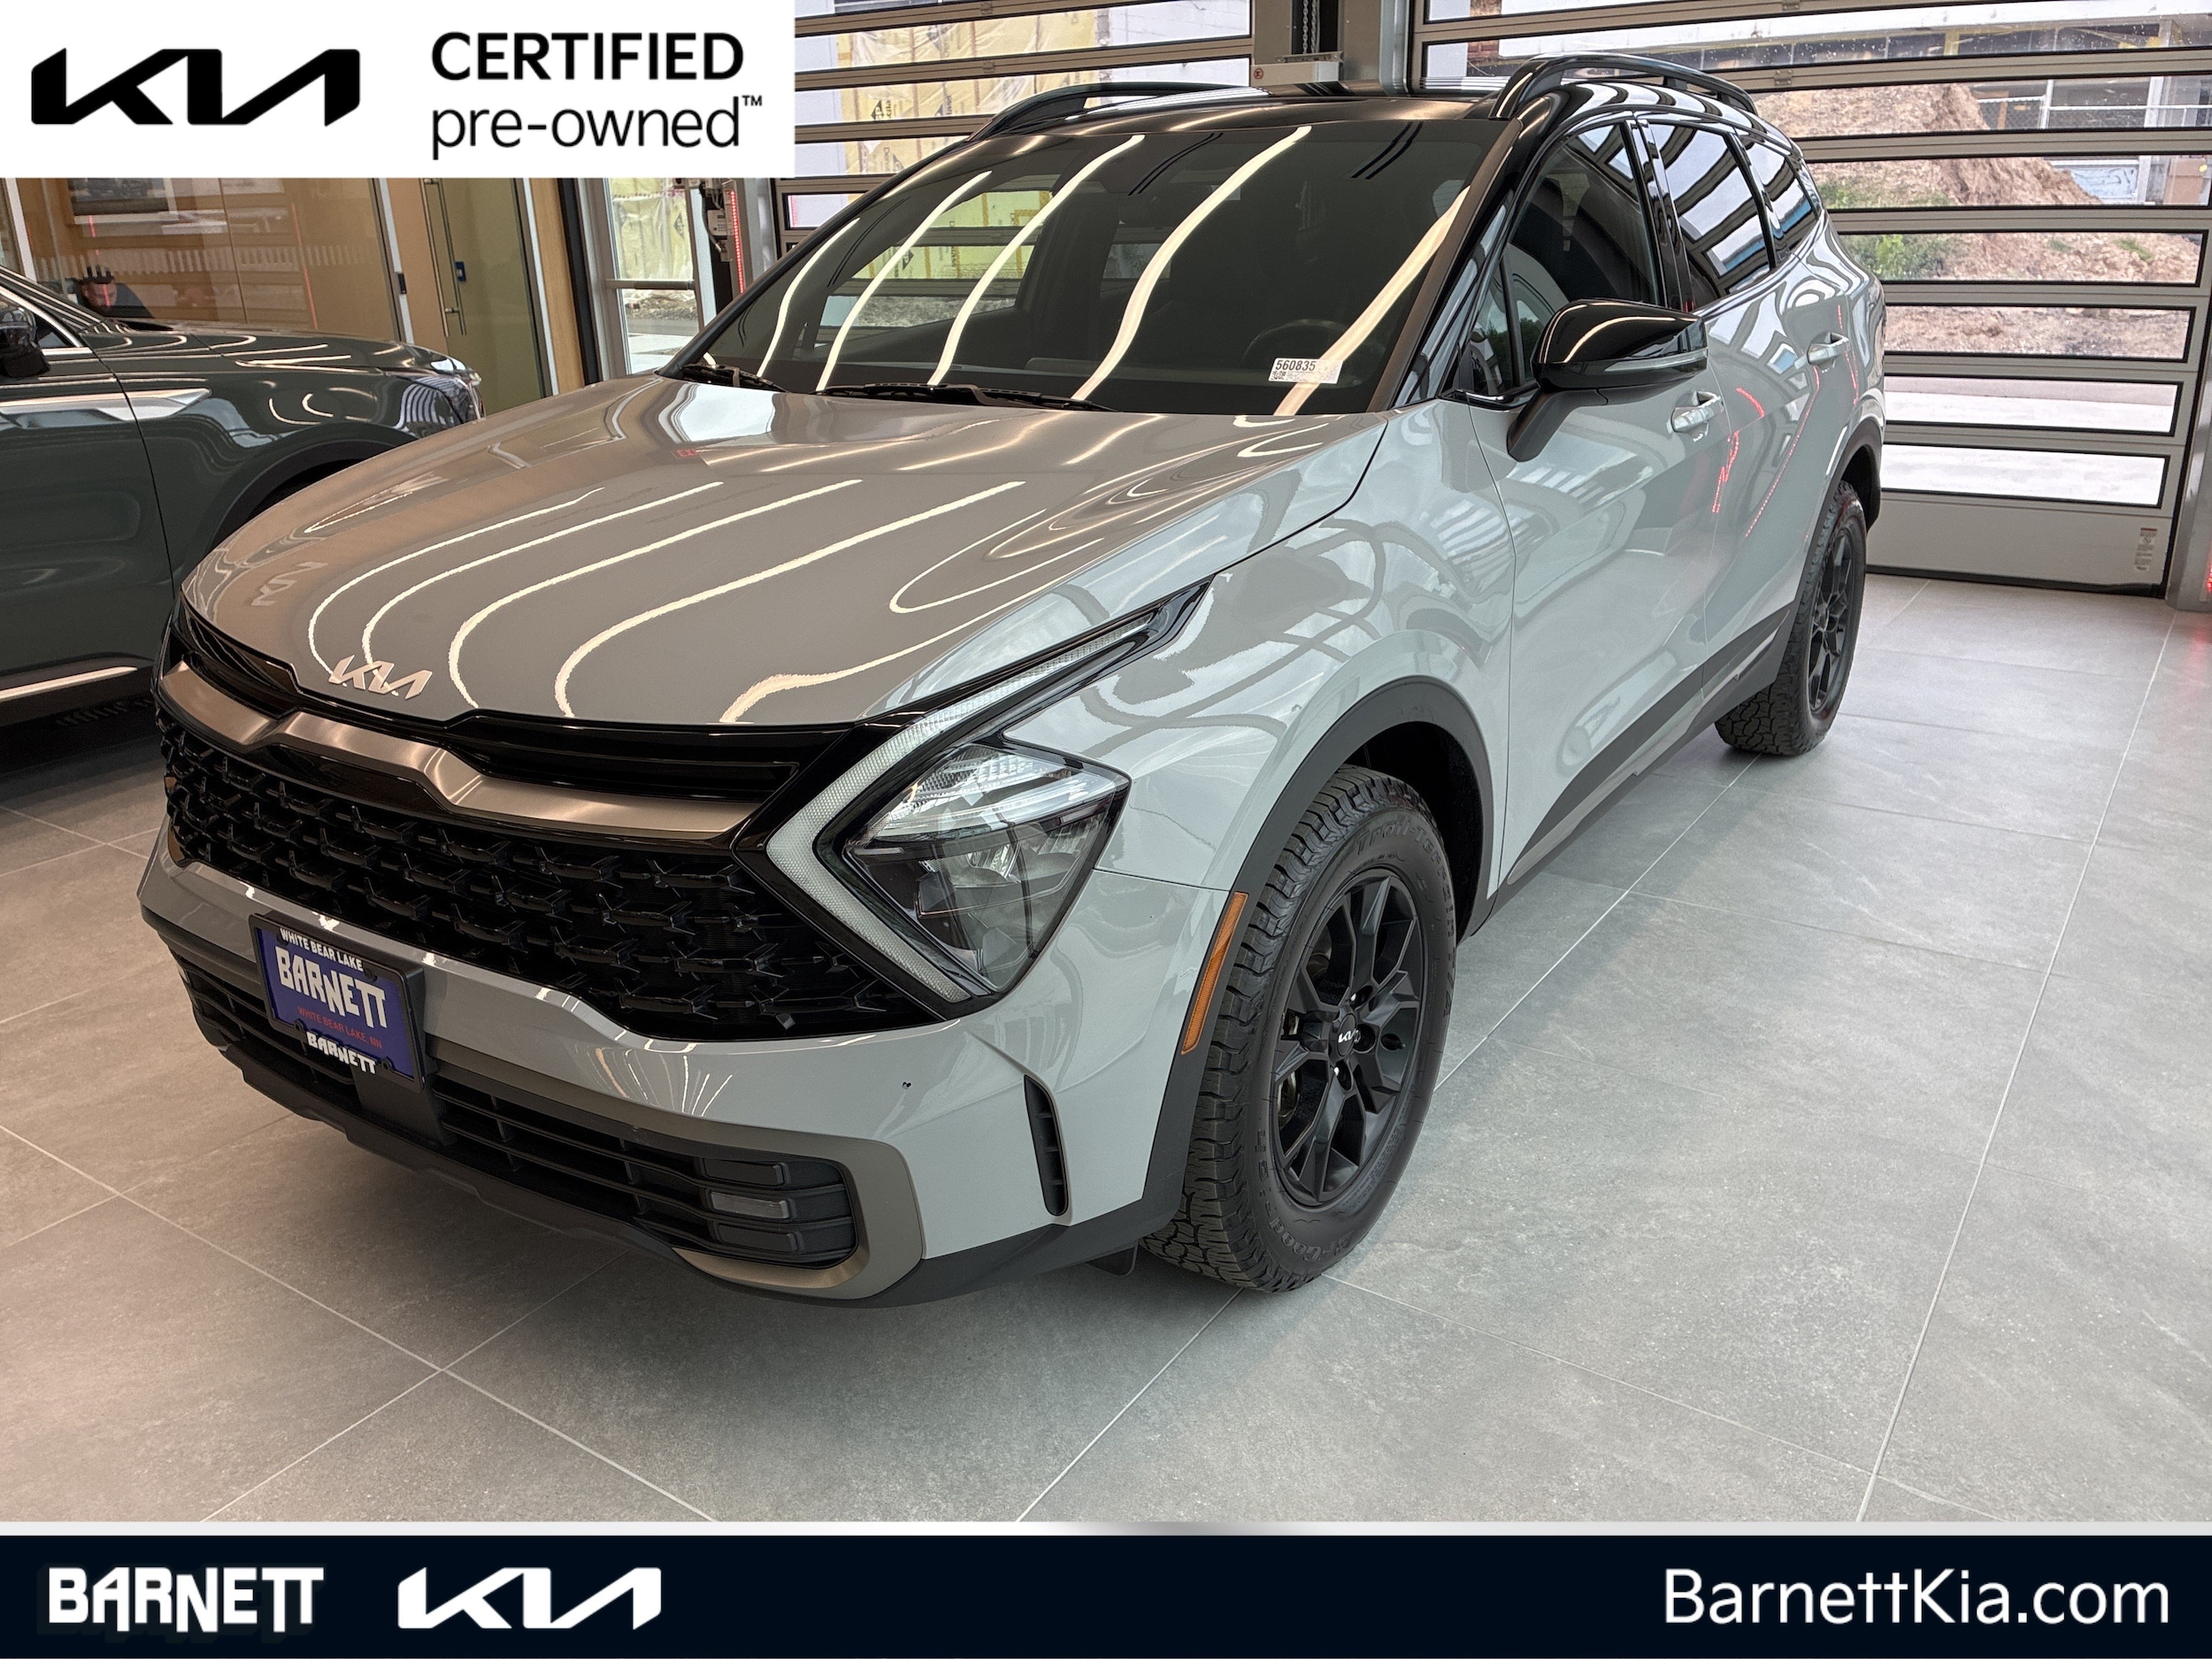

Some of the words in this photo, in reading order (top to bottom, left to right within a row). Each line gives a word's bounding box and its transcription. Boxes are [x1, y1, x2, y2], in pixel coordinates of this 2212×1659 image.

[1275, 360, 1317, 371] 560835
[280, 928, 310, 950] WHITE
[310, 941, 335, 960] BEAR
[336, 951, 364, 972] LAKE
[275, 946, 388, 1029] BARNETT
[297, 1006, 321, 1024] WHITE
[322, 1017, 345, 1033] BEAR
[369, 1033, 382, 1049] MN
[306, 1031, 376, 1074] BARNETT
